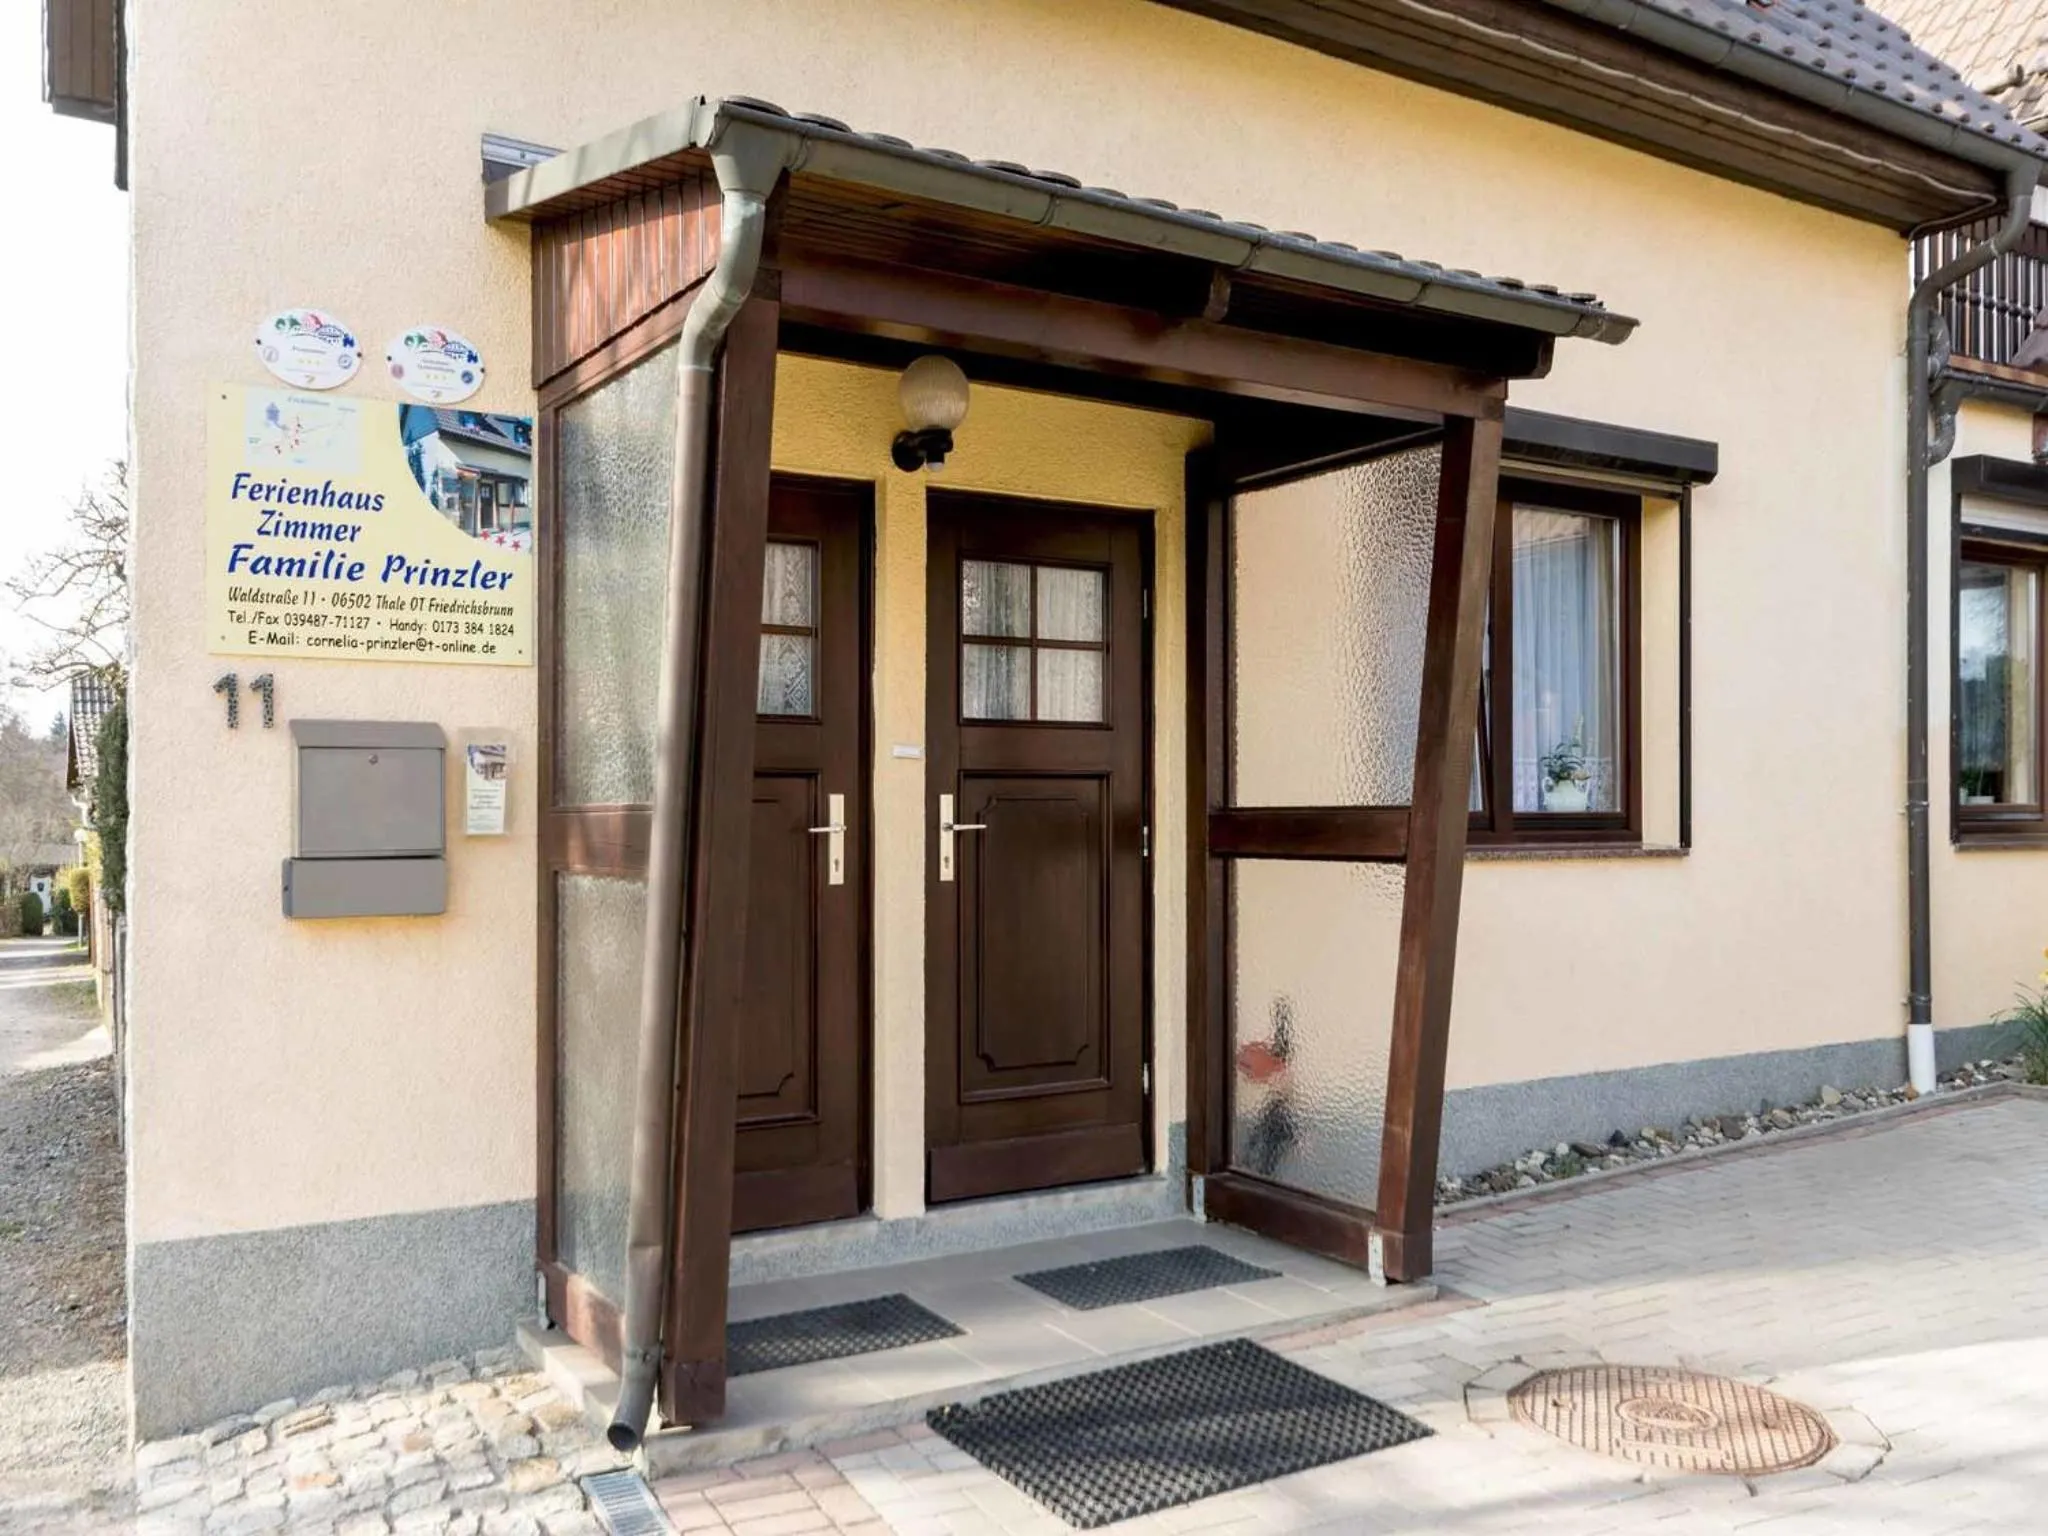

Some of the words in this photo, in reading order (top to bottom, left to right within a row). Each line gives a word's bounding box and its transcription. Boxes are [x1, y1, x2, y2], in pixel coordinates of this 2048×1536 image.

[231, 472, 385, 512] Ferienhaus
[256, 509, 362, 542] Zimmer
[228, 543, 365, 582] Familie
[381, 554, 513, 590] Prinzler
[228, 586, 299, 606] Waldstraße
[303, 590, 316, 606] 11
[331, 592, 371, 609] 06502
[376, 594, 406, 611] Thale
[410, 597, 426, 611] OT
[428, 597, 514, 617] Friedrichsbrunn
[228, 610, 279, 625] Tel./Fax
[284, 612, 370, 629] 039487-71127
[390, 618, 427, 635] Handy:
[432, 620, 459, 633] 0173
[464, 621, 484, 635] 384
[489, 623, 514, 636] 1824
[248, 630, 300, 645] E-Mail:
[306, 634, 497, 654] cornelia-prinzler@t-online.de
[212, 673, 274, 728] 11
